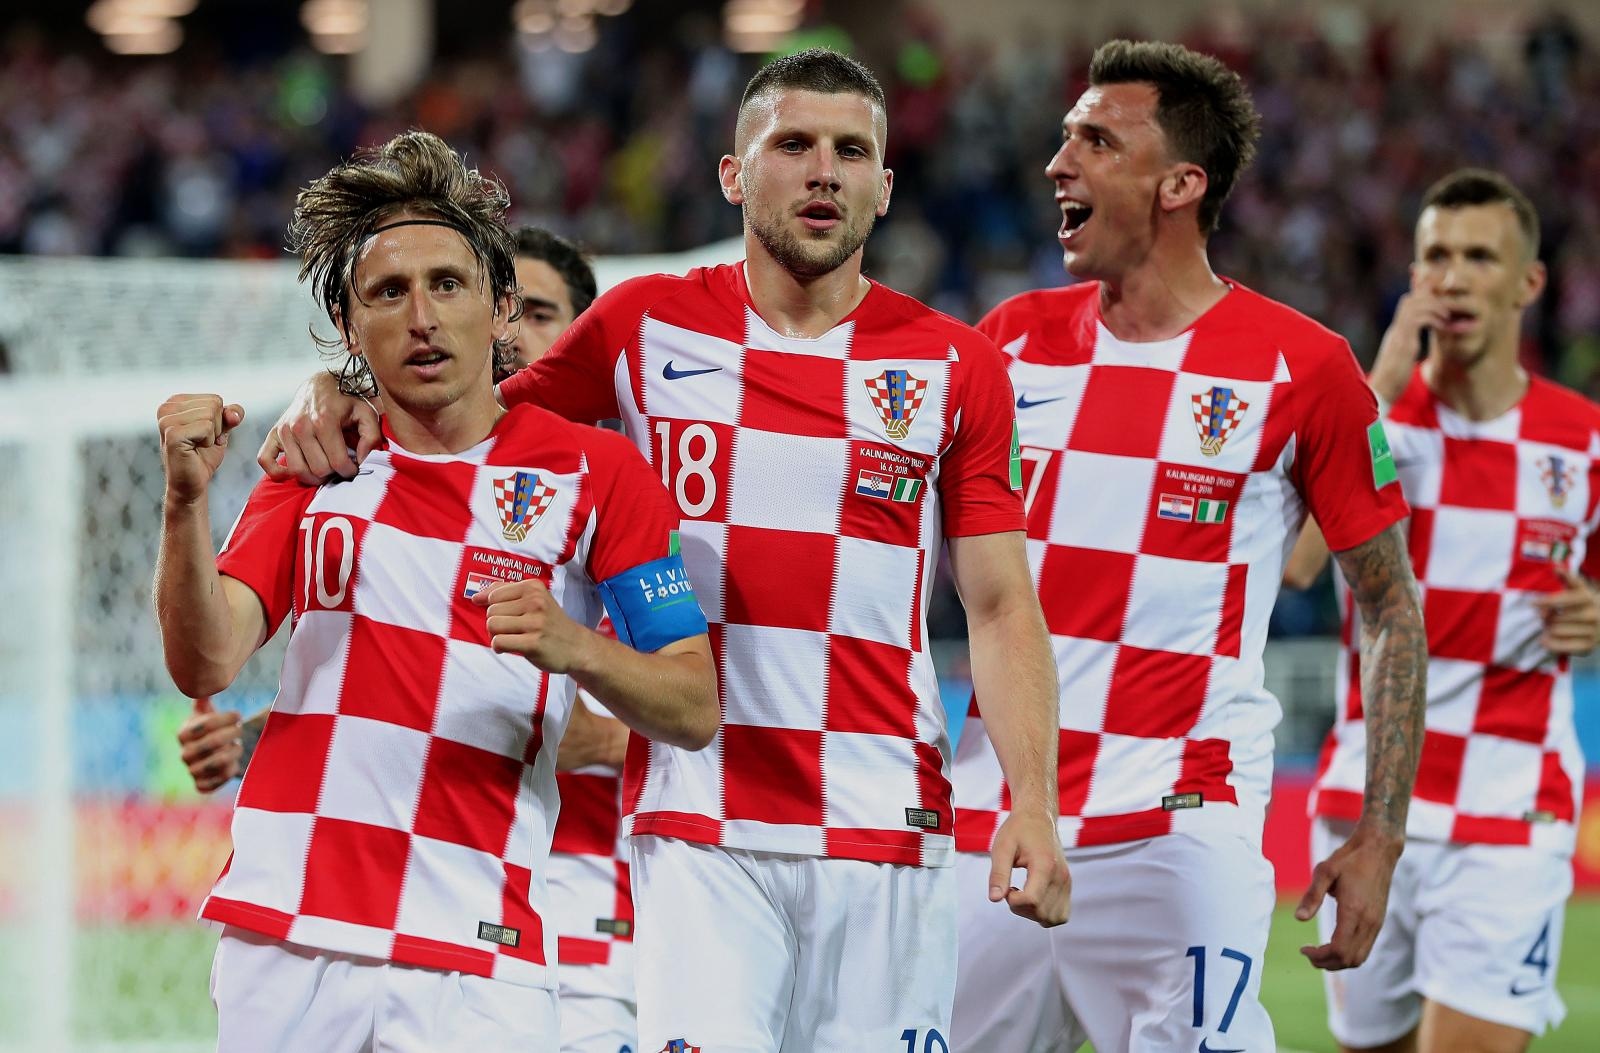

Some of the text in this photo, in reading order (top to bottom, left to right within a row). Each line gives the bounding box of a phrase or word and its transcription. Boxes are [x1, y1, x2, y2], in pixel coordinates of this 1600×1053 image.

[655, 421, 718, 517] 18
[859, 447, 910, 465] KALINJINGRAD
[299, 516, 354, 610] 10
[472, 551, 542, 577] KALINJINGRAD (RUS)
[1524, 919, 1550, 977] 4
[1185, 946, 1253, 1034] 17
